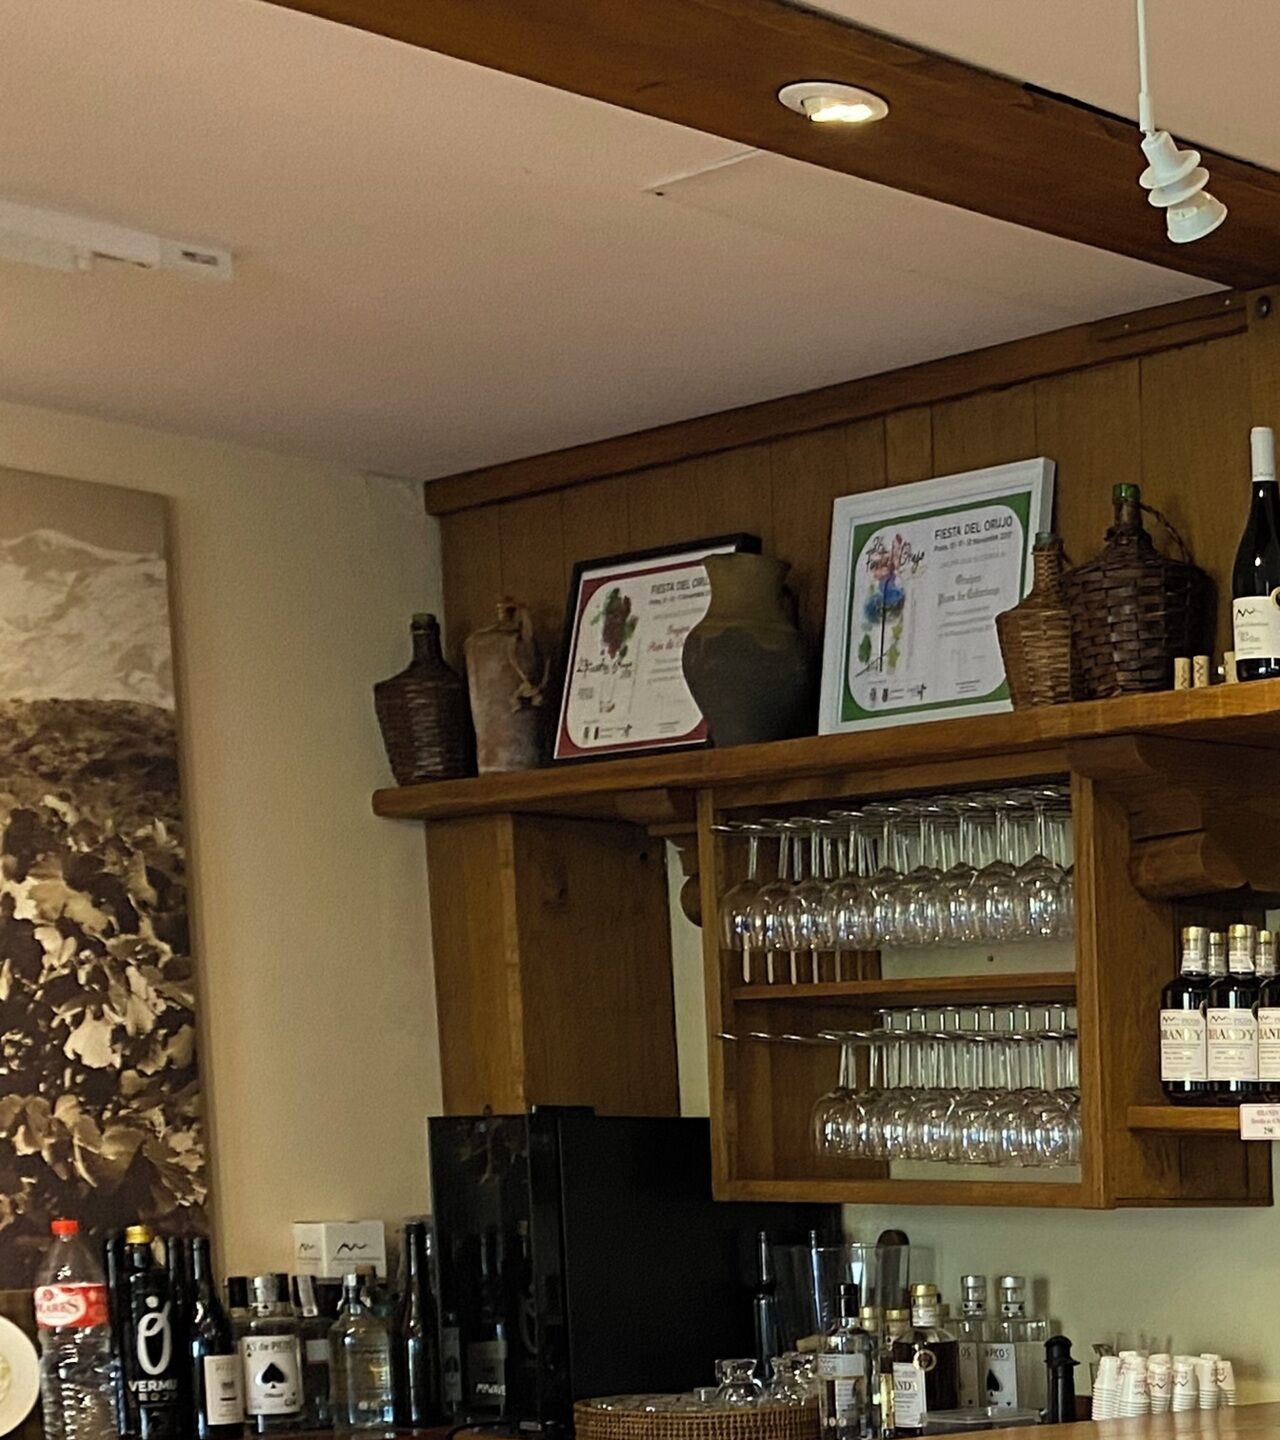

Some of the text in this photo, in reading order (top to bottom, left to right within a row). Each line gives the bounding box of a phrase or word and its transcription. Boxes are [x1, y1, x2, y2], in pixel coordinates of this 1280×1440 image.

[934, 515, 1013, 540] FIESTA DEL ORUJO
[651, 580, 690, 594] FIESTA DEL
